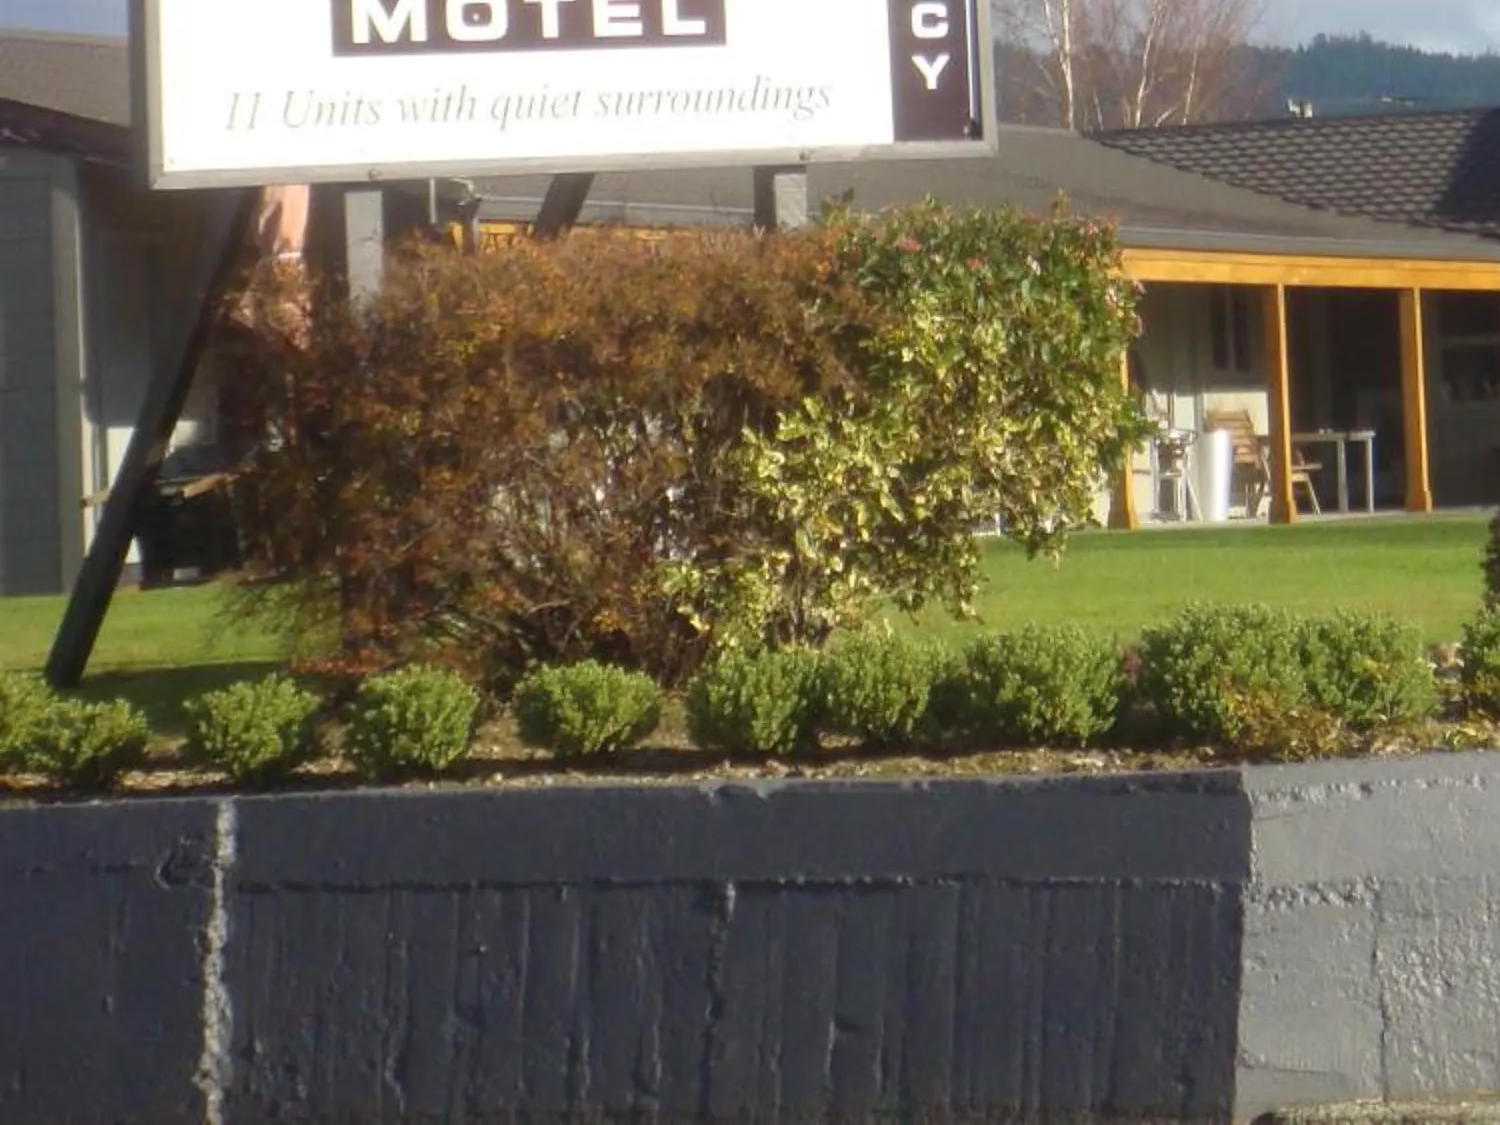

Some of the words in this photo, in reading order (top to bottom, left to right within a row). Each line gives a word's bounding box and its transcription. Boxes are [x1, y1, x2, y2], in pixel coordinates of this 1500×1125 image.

[282, 89, 383, 129] Units
[397, 83, 476, 123] with
[489, 83, 583, 133] quiet
[595, 74, 832, 122] surroundings
